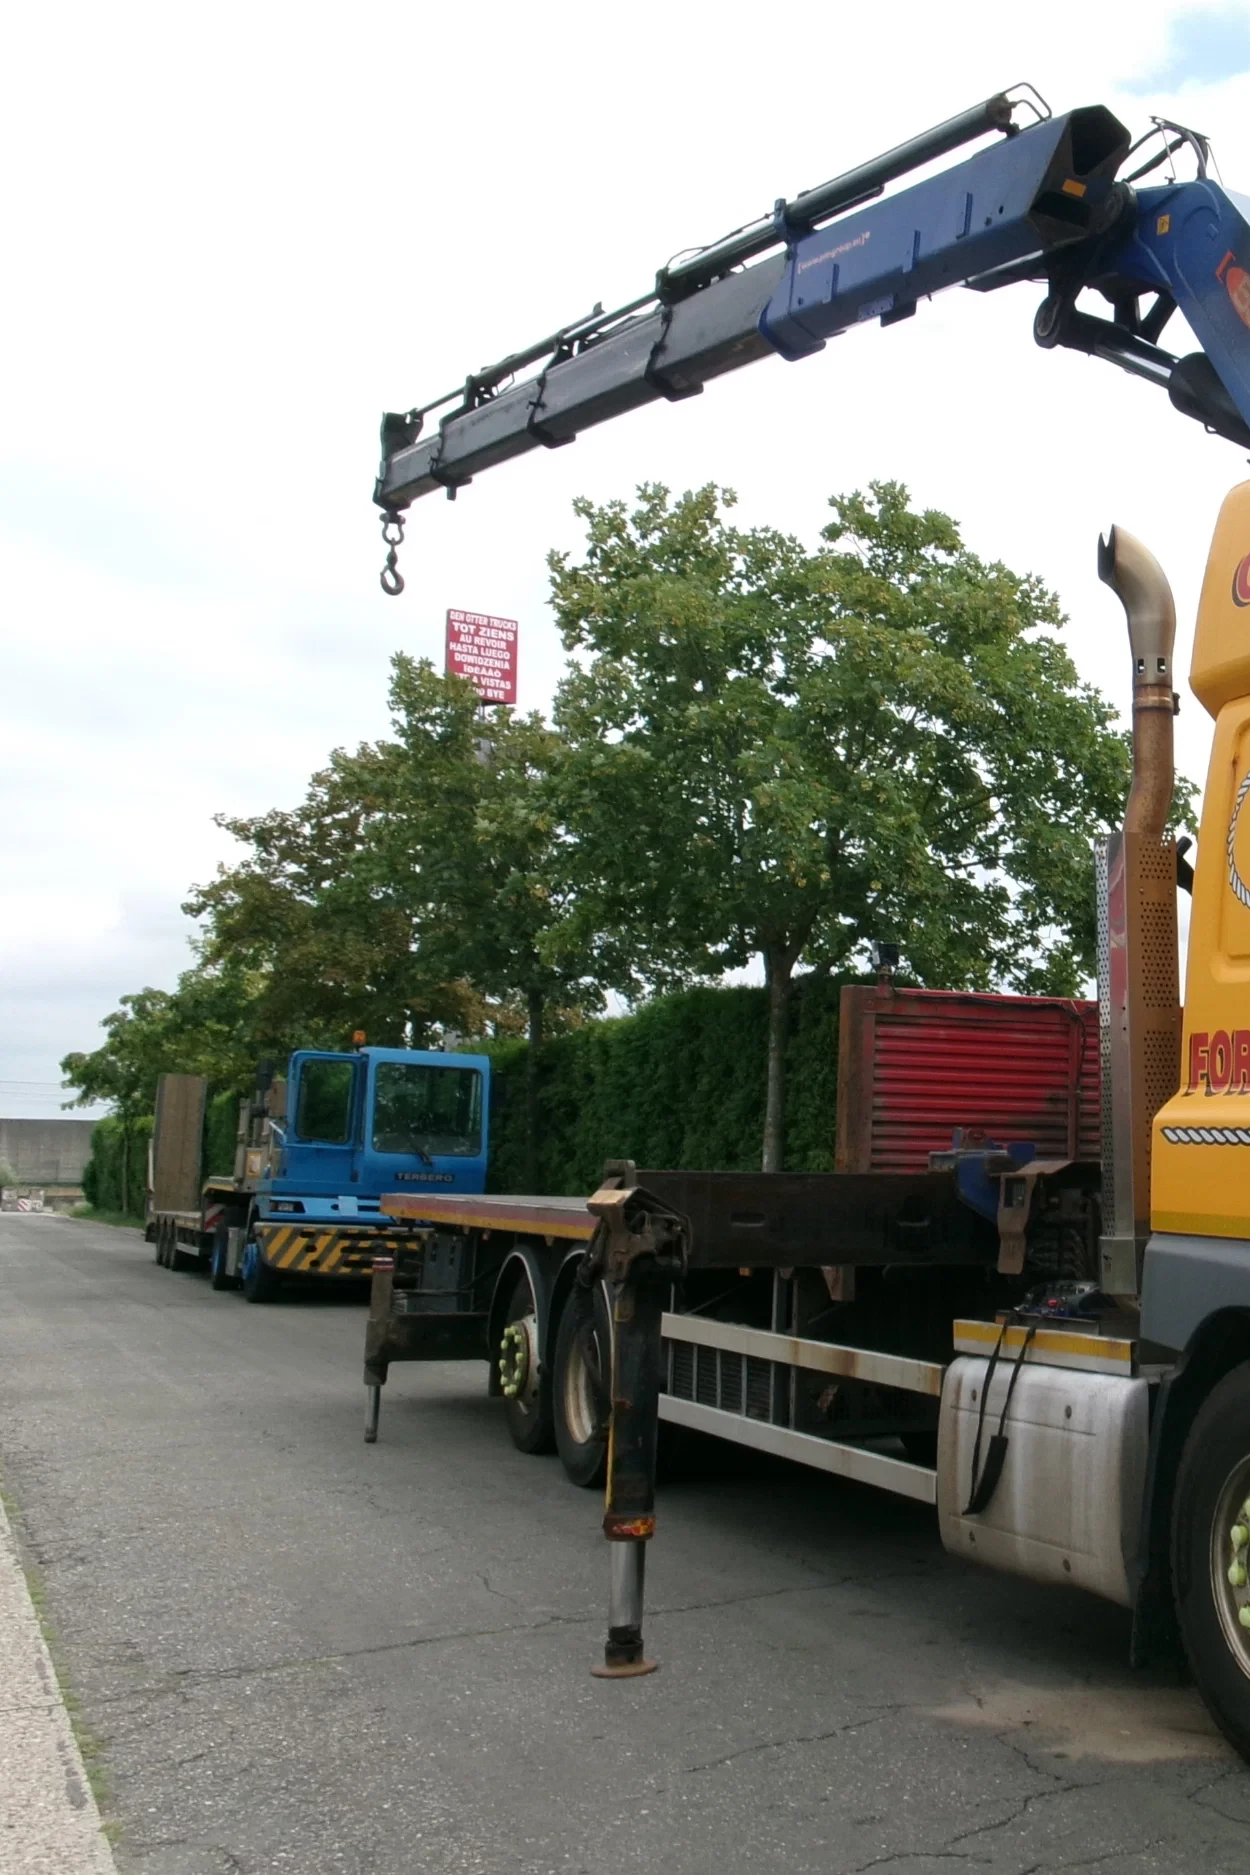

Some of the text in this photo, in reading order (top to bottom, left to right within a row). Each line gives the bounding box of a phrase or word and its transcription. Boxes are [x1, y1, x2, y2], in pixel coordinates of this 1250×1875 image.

[452, 621, 515, 641] TOT ZIENS
[490, 618, 517, 631] TRUCKS
[459, 633, 507, 650] AU REVOIR
[449, 641, 510, 660] HASTA LUEGO
[480, 676, 511, 690] VISTAS
[486, 688, 505, 699] BYE
